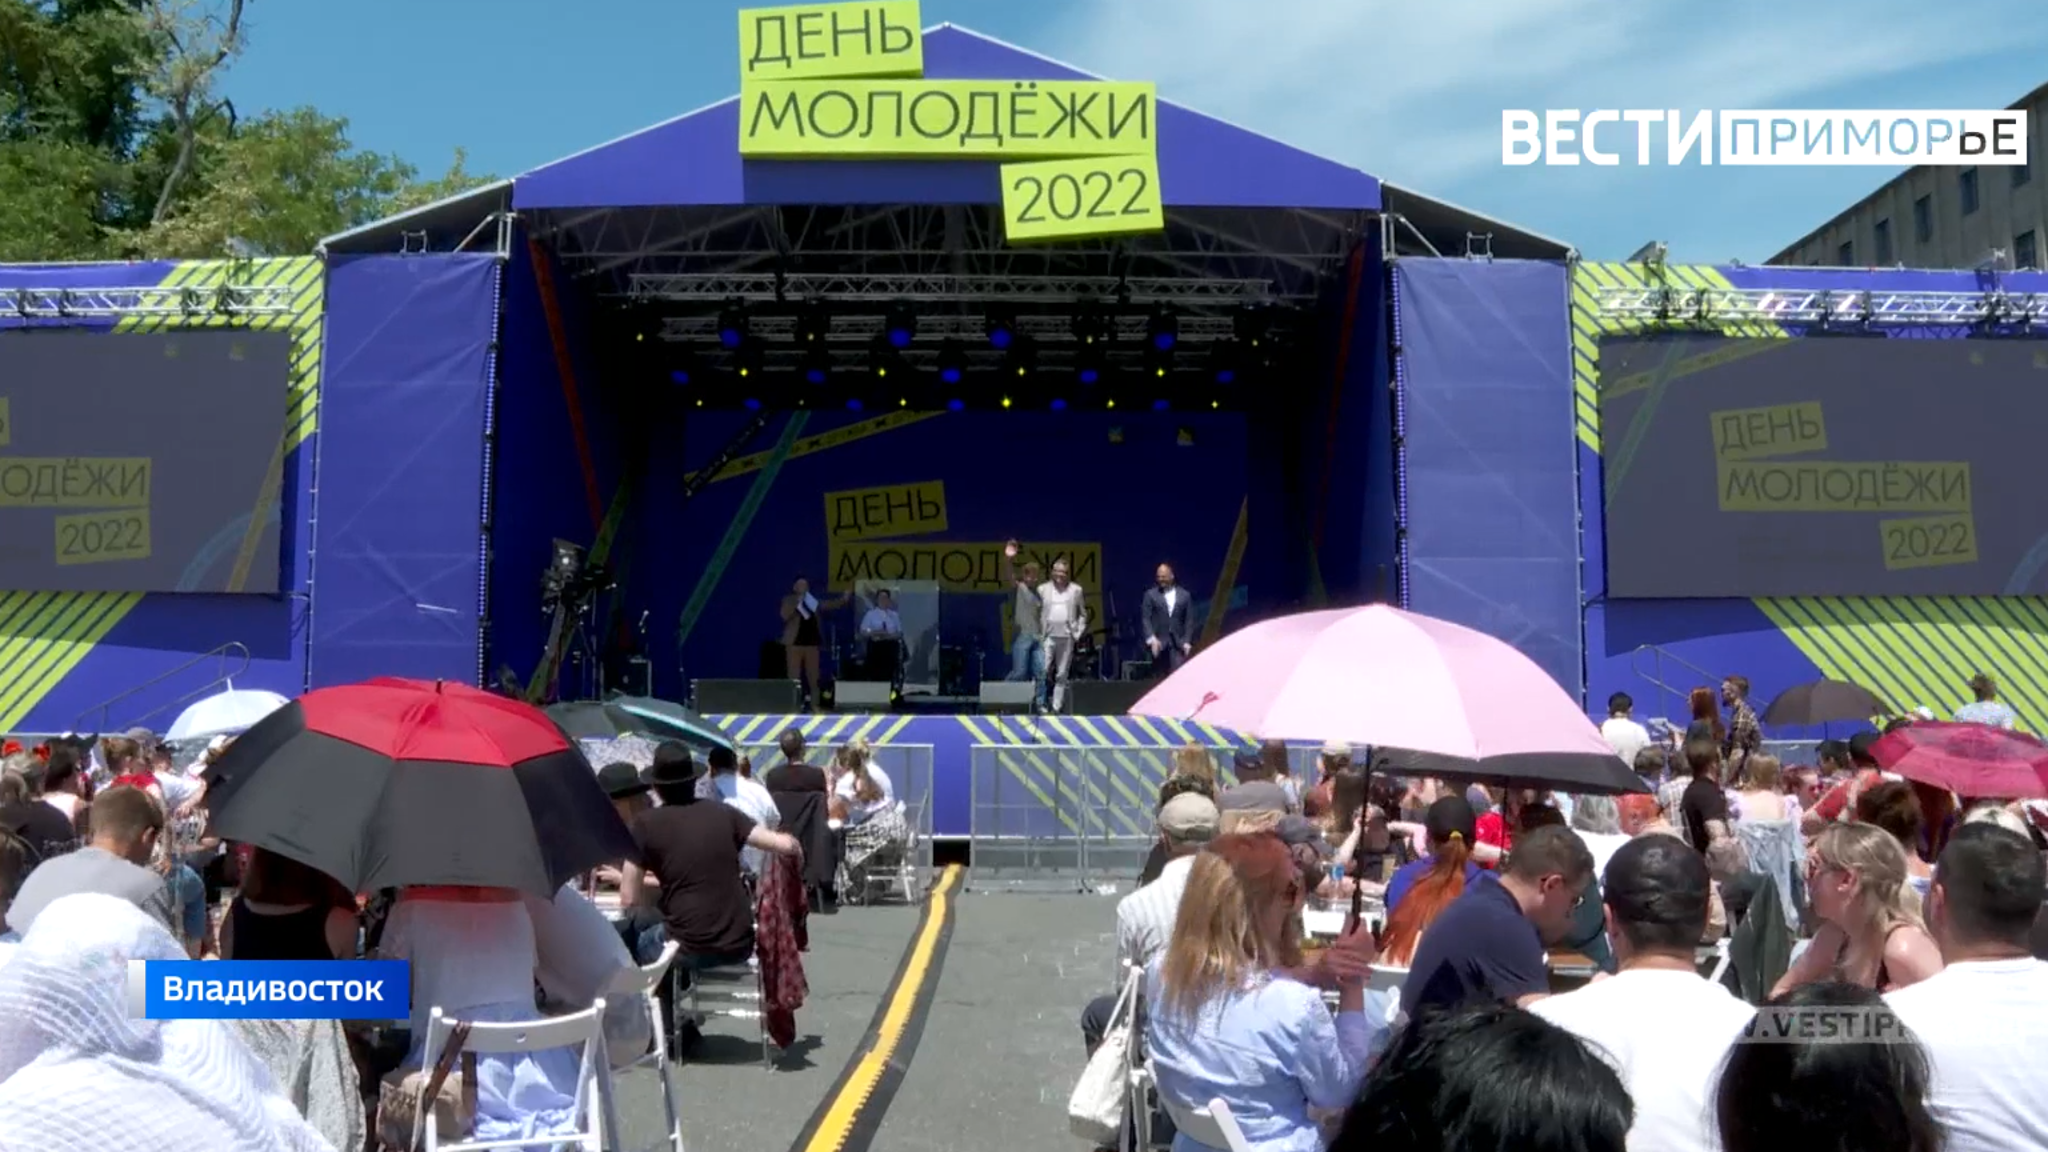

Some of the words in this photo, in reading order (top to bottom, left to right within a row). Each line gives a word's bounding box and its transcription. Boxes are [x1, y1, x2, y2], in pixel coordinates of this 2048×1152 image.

[748, 8, 914, 72] ДЕНЬ
[748, 82, 1148, 147] МОЛОДЁЖИ
[1013, 168, 1151, 224] 2022
[1719, 408, 1821, 455] ДЕНЬ
[1725, 463, 1967, 507] МОЛОДЁЖИ
[832, 488, 941, 536] ДЕНЬ
[61, 517, 144, 556] 2022
[1888, 521, 1970, 561] 2022
